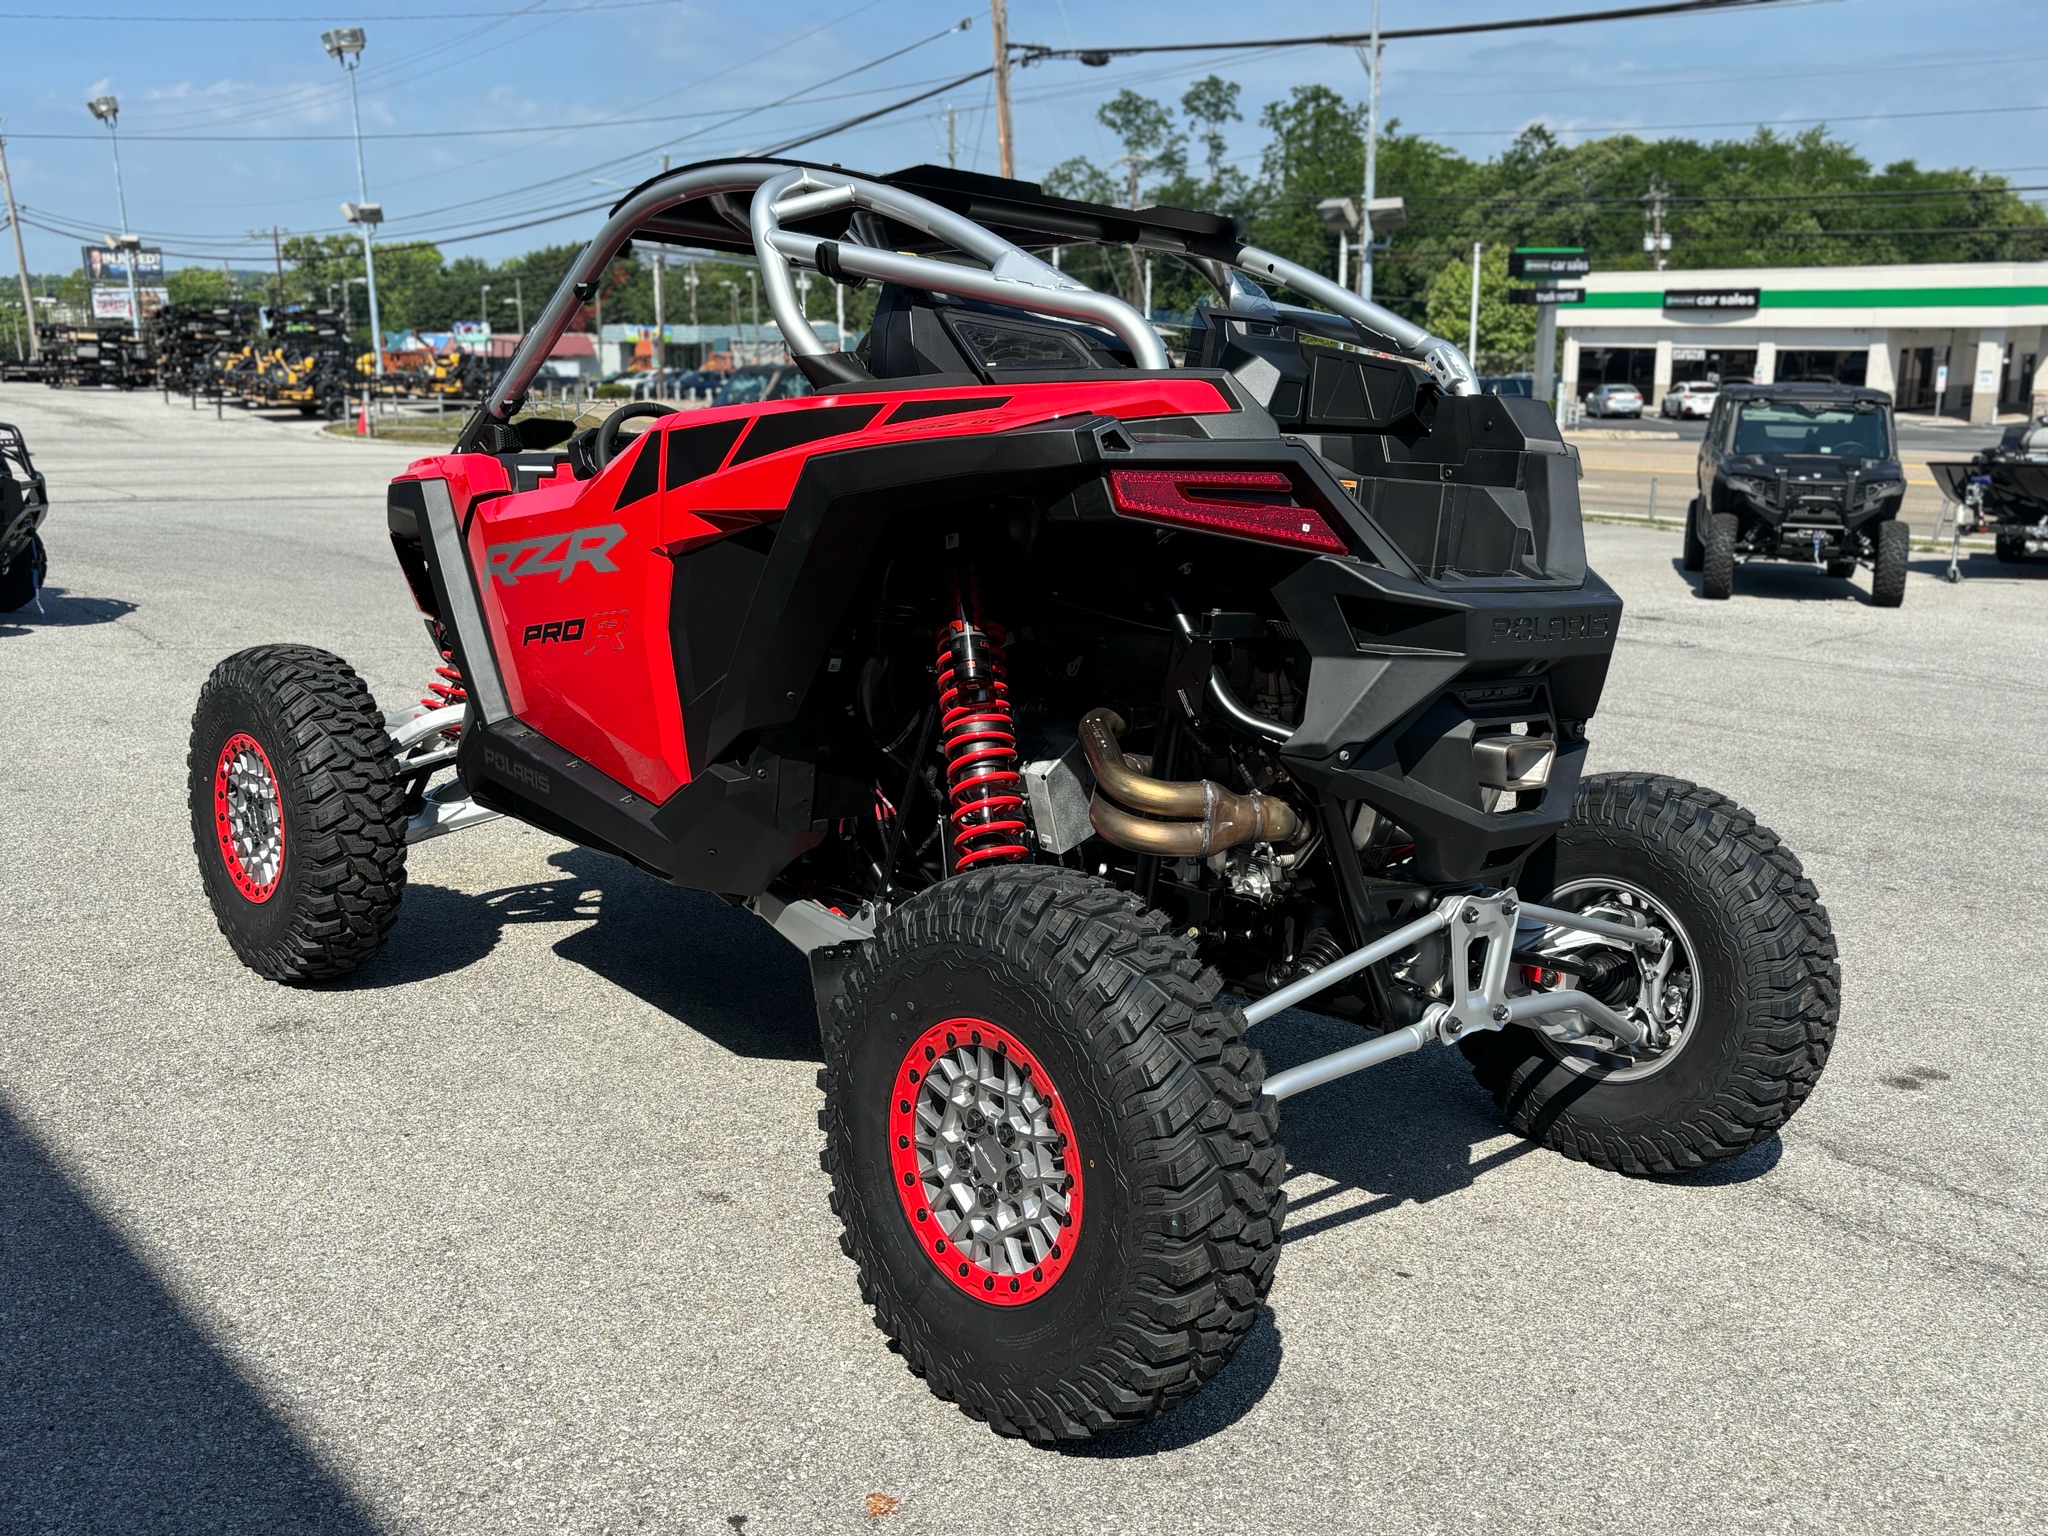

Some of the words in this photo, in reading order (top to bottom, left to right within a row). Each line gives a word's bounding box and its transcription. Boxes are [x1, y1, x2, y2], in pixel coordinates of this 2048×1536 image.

[1550, 260, 1567, 272] car
[1567, 257, 1589, 272] sales
[1696, 295, 1718, 306] car
[1719, 292, 1756, 306] sales
[482, 523, 628, 593] RZR
[522, 618, 586, 647] PRO
[584, 609, 629, 656] R
[1490, 613, 1609, 643] POLARIS
[484, 745, 550, 793] POLARIS
